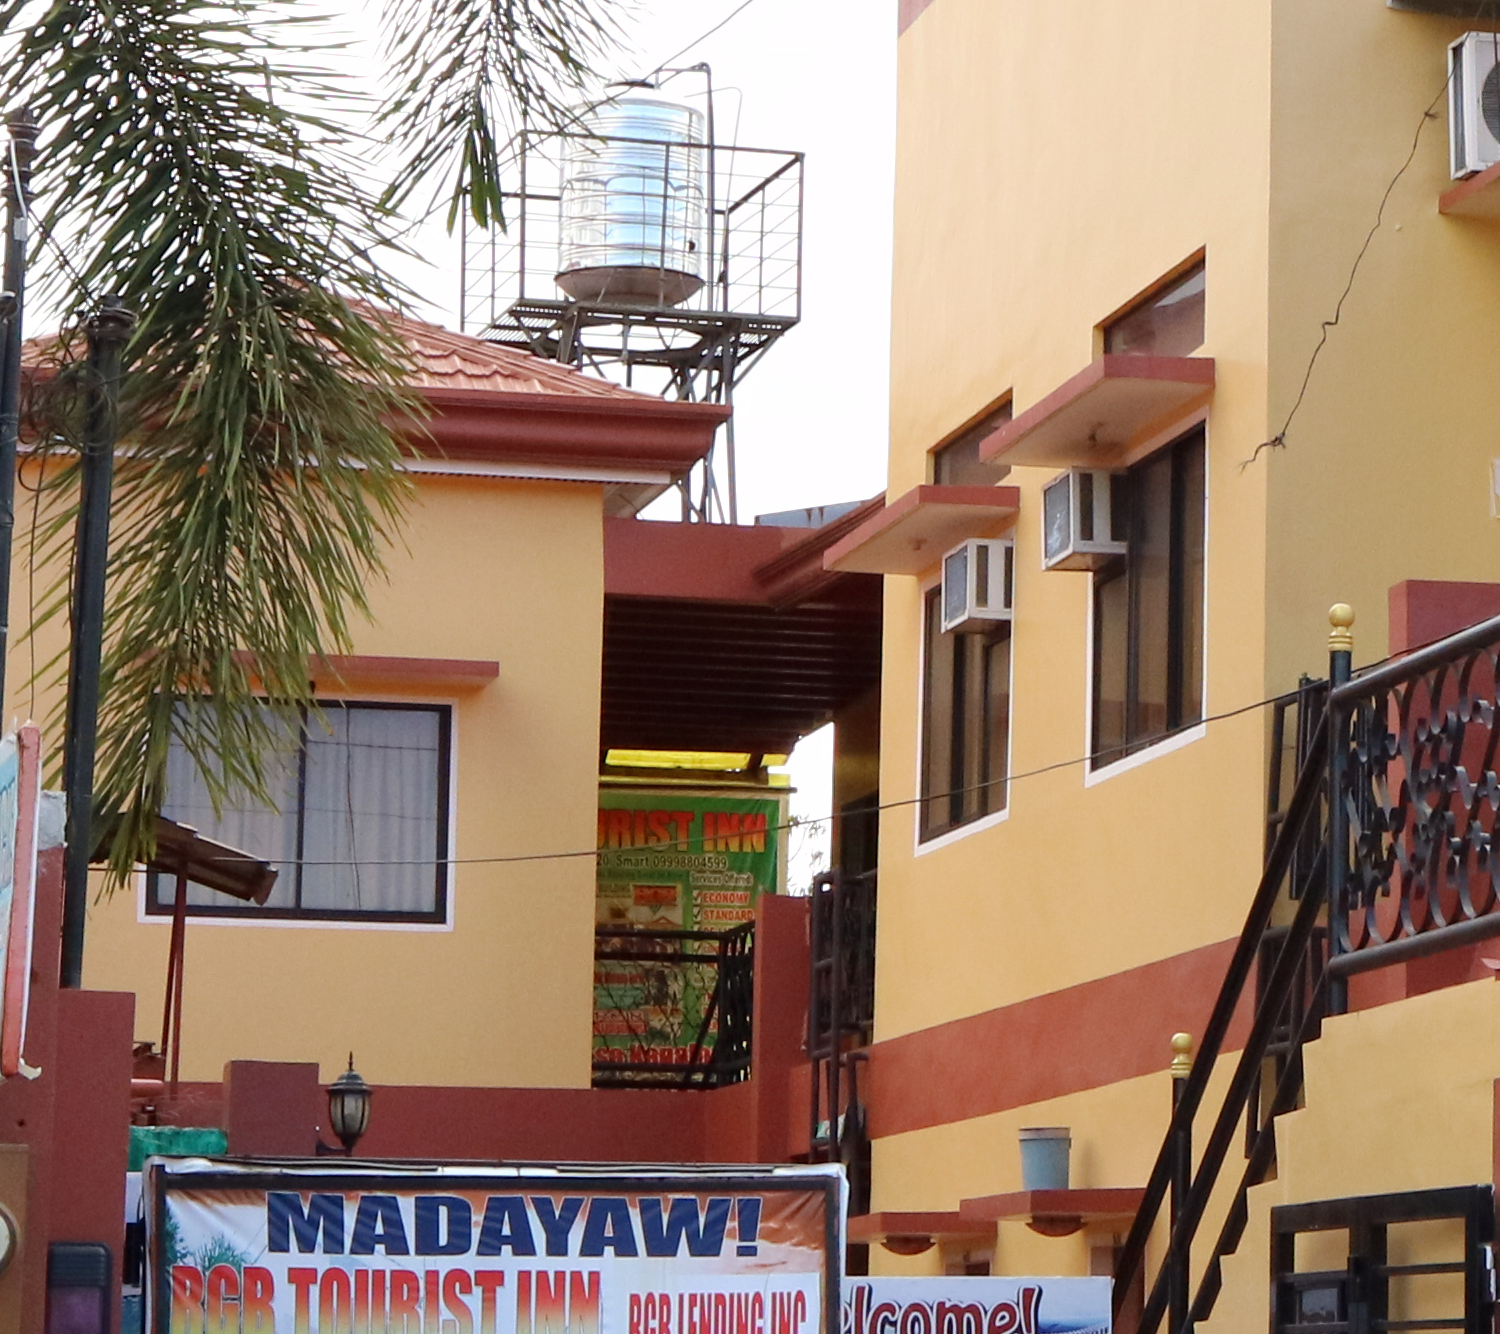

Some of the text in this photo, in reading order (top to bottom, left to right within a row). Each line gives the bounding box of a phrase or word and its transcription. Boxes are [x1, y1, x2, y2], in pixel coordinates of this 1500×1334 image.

[702, 812, 768, 854] INN
[616, 854, 650, 867] Smart
[702, 892, 750, 905] ECONOMY
[702, 908, 755, 922] STANDARD
[266, 1192, 762, 1257] MADAYAW!
